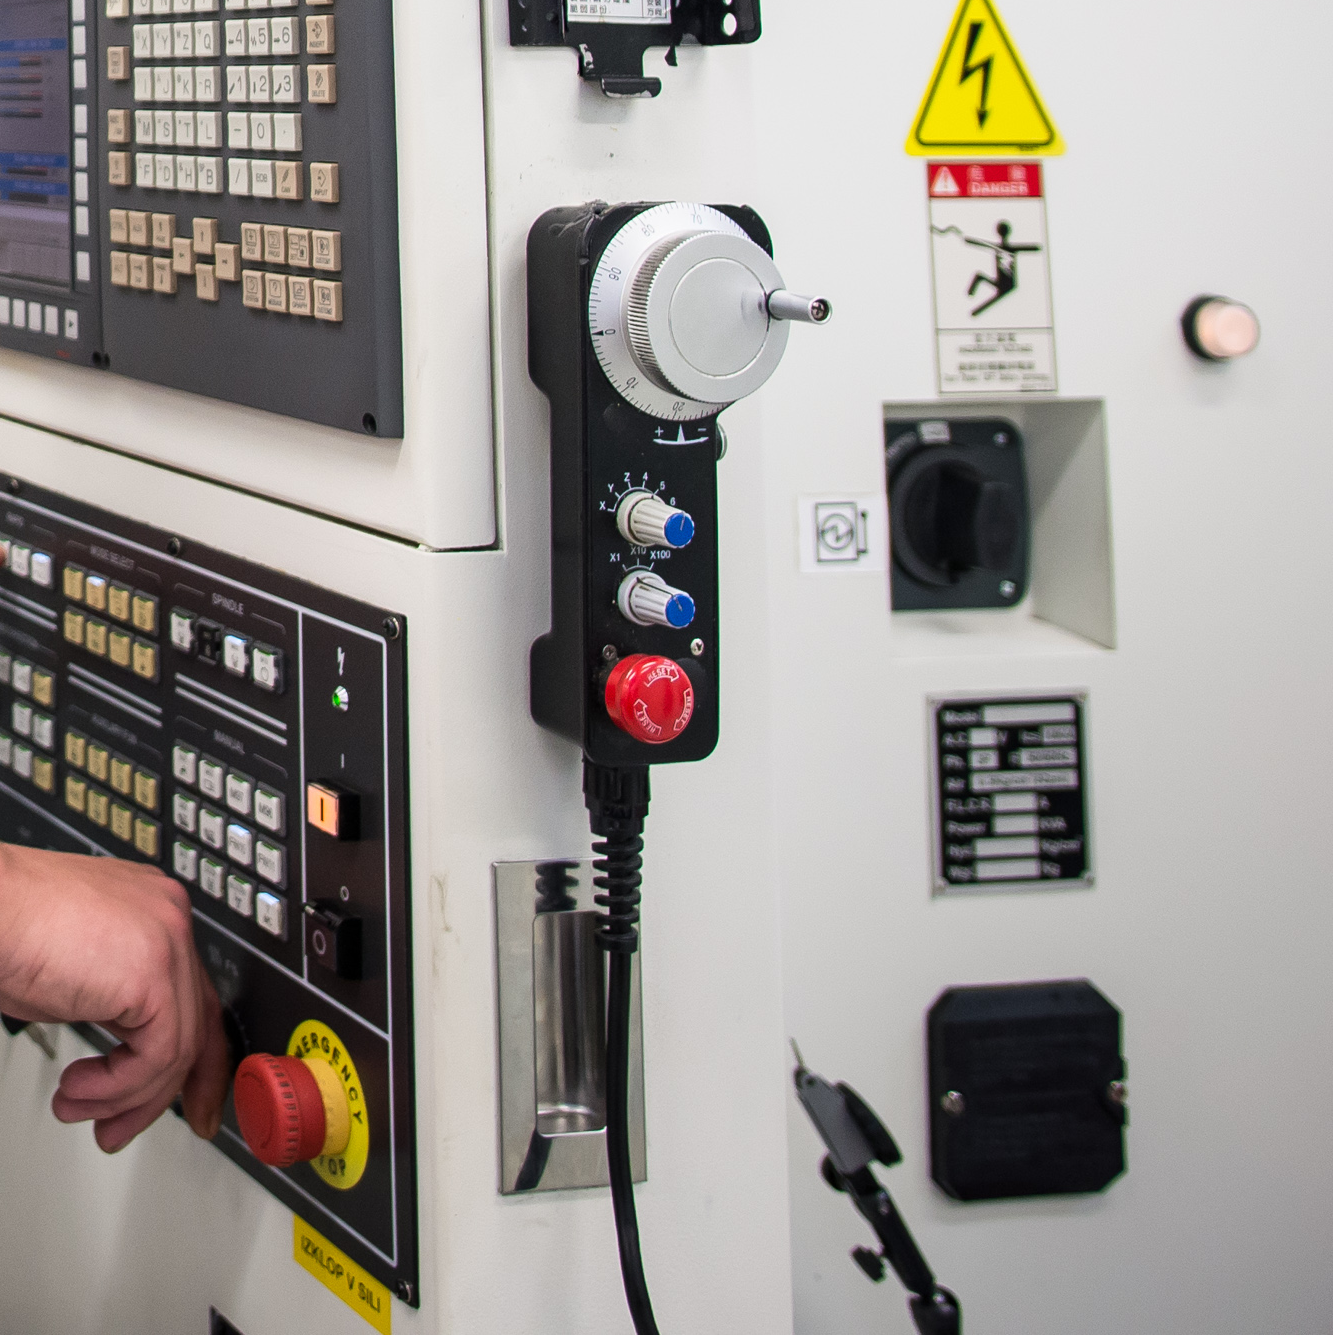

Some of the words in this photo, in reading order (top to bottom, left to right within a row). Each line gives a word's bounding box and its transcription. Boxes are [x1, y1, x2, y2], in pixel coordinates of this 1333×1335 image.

[142, 35, 148, 50] X
[162, 35, 168, 50] Y
[182, 34, 189, 50] Z
[204, 34, 212, 50] Q
[236, 29, 242, 44] 4
[258, 28, 266, 44] 5
[282, 26, 290, 44] 6
[162, 80, 170, 94] J
[183, 79, 190, 94] K
[204, 79, 212, 94] R
[238, 76, 242, 91] 1
[260, 75, 266, 92] 2
[284, 75, 291, 92] 3
[142, 122, 150, 136] M
[163, 122, 170, 137] S
[184, 122, 191, 138] T
[206, 124, 212, 140] L
[144, 164, 150, 179] F
[164, 166, 170, 182] D
[185, 168, 192, 183] H
[206, 169, 213, 185] B
[256, 173, 268, 182] EOB
[972, 182, 1028, 193] DANGER
[691, 214, 702, 224] 70
[642, 224, 656, 238] 80
[608, 266, 622, 281] 90
[626, 376, 639, 389] 10
[672, 401, 686, 412] 20
[624, 472, 630, 482] Z
[643, 472, 648, 481] 4
[608, 484, 614, 493] Y
[660, 481, 666, 490] 5
[600, 501, 606, 510] X
[670, 497, 676, 506] 6
[610, 553, 620, 562] X1
[630, 546, 646, 556] X10
[650, 550, 670, 560] X100
[212, 592, 244, 618] SPINDLE
[648, 668, 671, 681] RESET
[682, 696, 692, 725] RESET
[637, 710, 656, 733] RESET
[214, 728, 246, 755] MANUAL
[946, 820, 986, 835] Power
[294, 1031, 363, 1125] MERGENCY
[300, 1234, 344, 1278] IZKLOP
[346, 1272, 355, 1291] V
[358, 1282, 380, 1314] SILI
